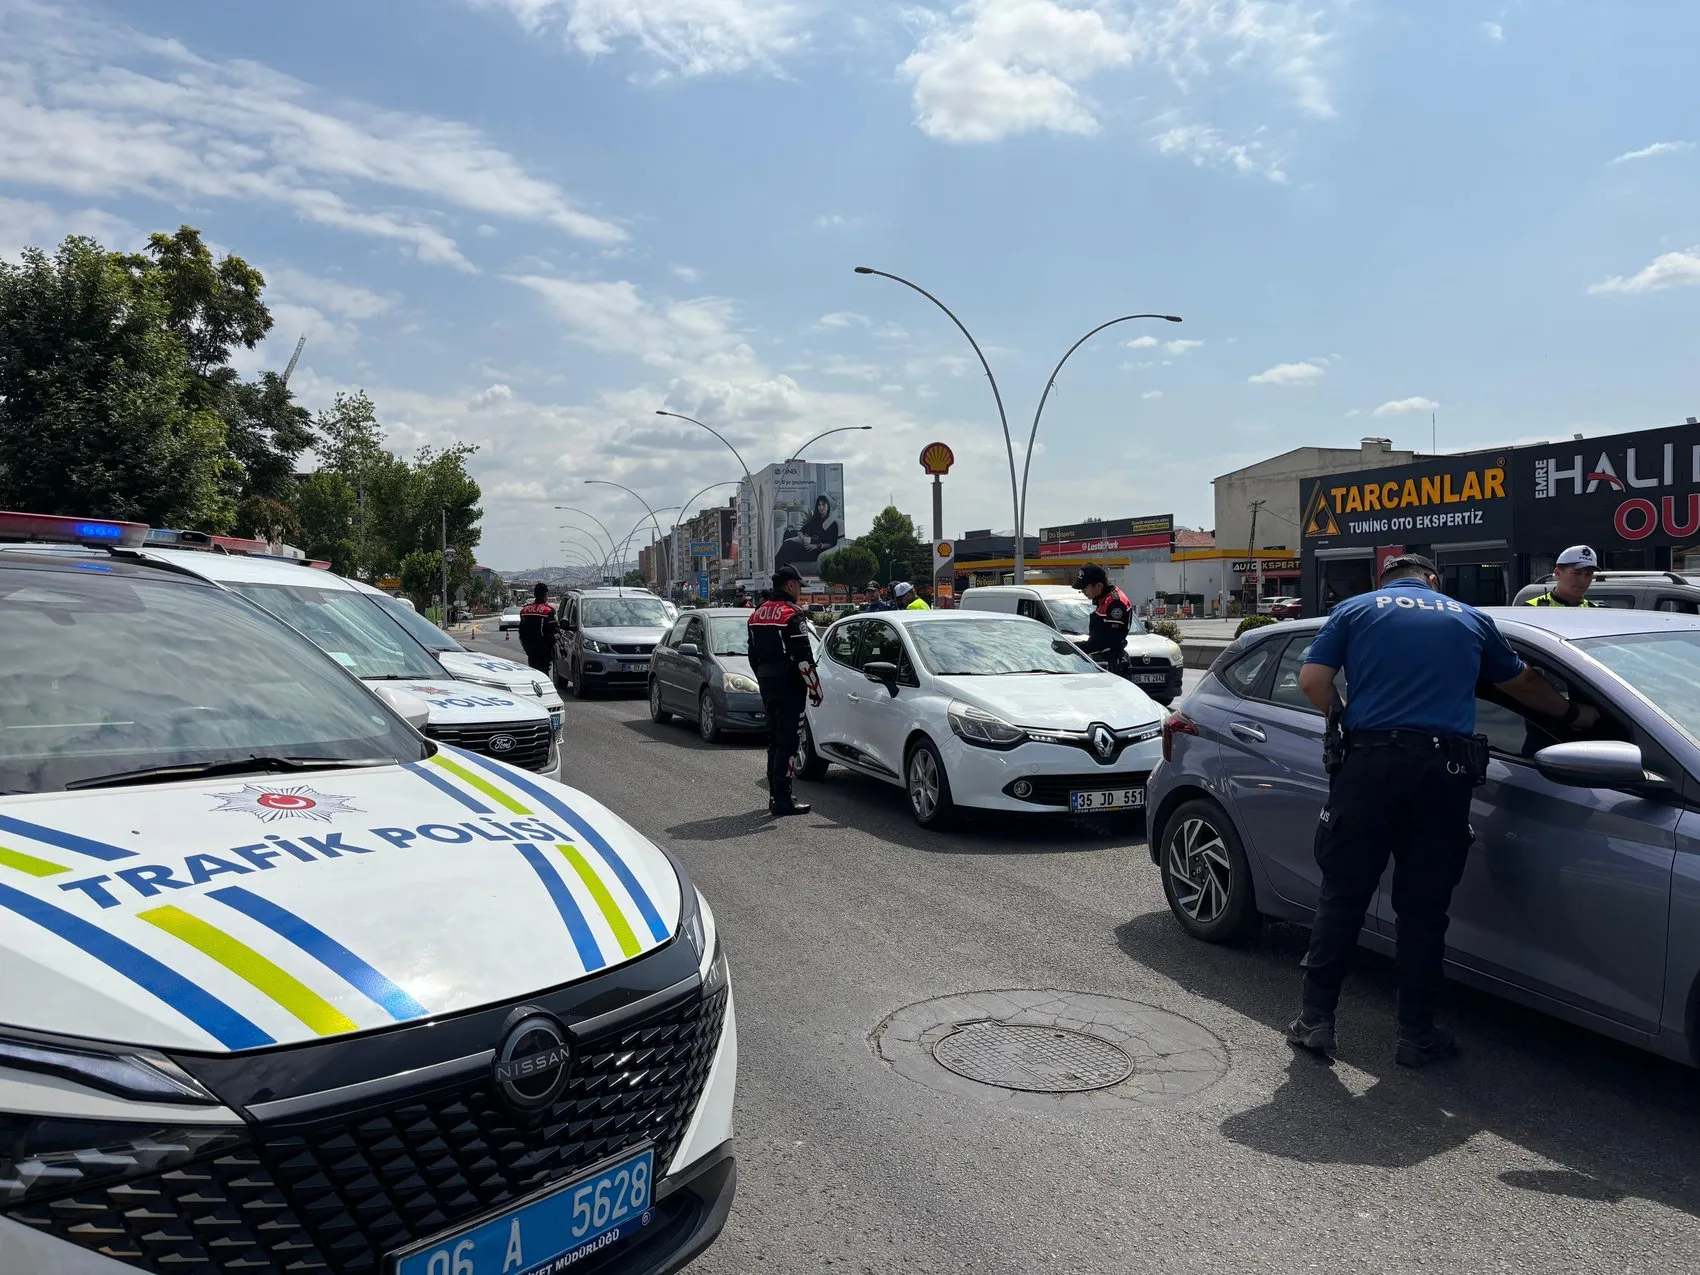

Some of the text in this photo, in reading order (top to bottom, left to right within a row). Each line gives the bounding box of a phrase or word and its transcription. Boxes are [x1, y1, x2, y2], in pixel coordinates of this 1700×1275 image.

[1535, 459, 1547, 498] EMRE
[1548, 443, 1700, 497] HALI
[1331, 467, 1506, 514] TARCANLAR
[1349, 508, 1483, 534] TUNİNG OTO EKSPERTİZ
[1613, 493, 1700, 540] OU
[1262, 561, 1300, 569] KSPERT
[754, 604, 782, 620] POLİS
[494, 738, 512, 749] Ford
[1079, 794, 1092, 807] 35
[1100, 792, 1114, 806] JD
[1124, 790, 1143, 804] 551
[57, 817, 576, 909] TRAFİK POLİSİ
[497, 1046, 570, 1079] NISSAN
[502, 1217, 523, 1274] A
[571, 1162, 649, 1238] 5628
[555, 1228, 620, 1271] MÜDÜRLÜĞÜ
